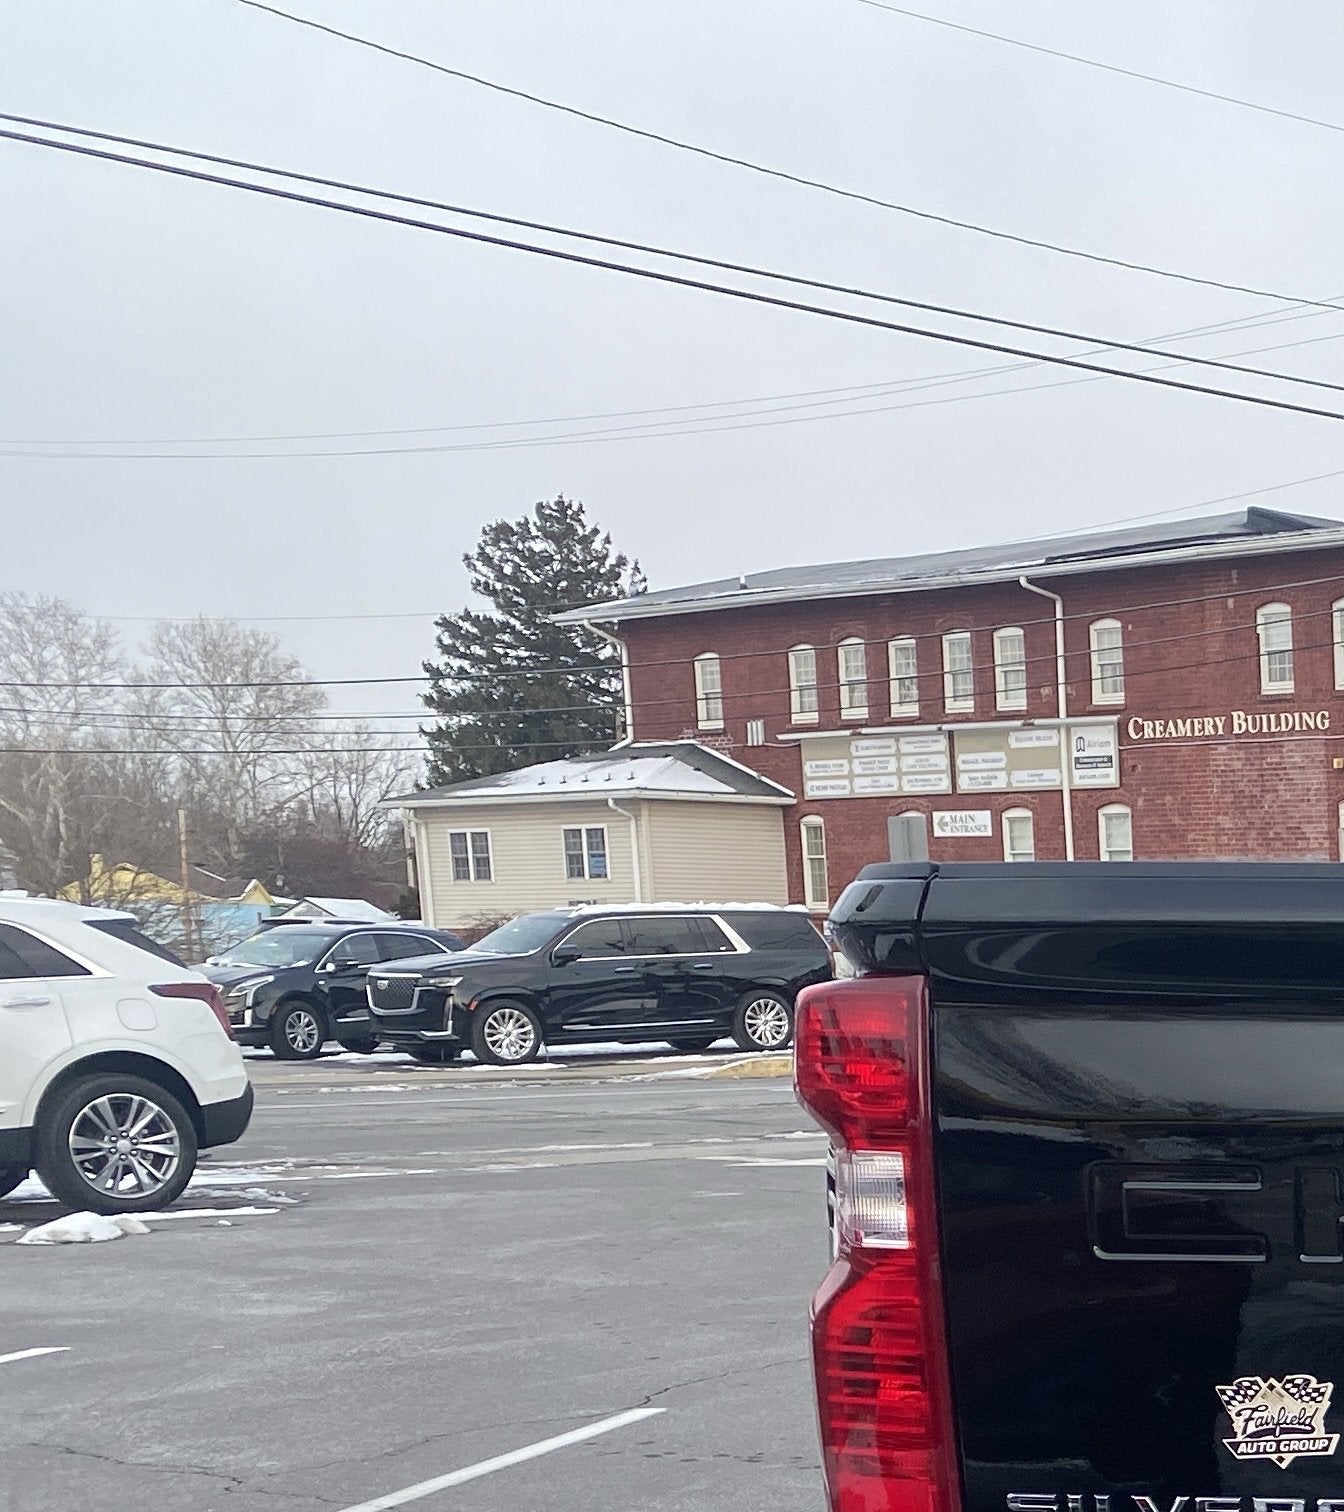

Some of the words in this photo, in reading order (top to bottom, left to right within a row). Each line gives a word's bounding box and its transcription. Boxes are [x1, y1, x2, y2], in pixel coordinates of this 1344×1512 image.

[1127, 716, 1227, 740] CREAMERY
[1231, 710, 1331, 735] BUILDING
[949, 814, 975, 825] MAIN
[950, 824, 988, 833] ENTRANCE
[1235, 1404, 1319, 1437] Fairfield
[1236, 1441, 1277, 1454] AUTO
[1280, 1439, 1329, 1453] GROUP
